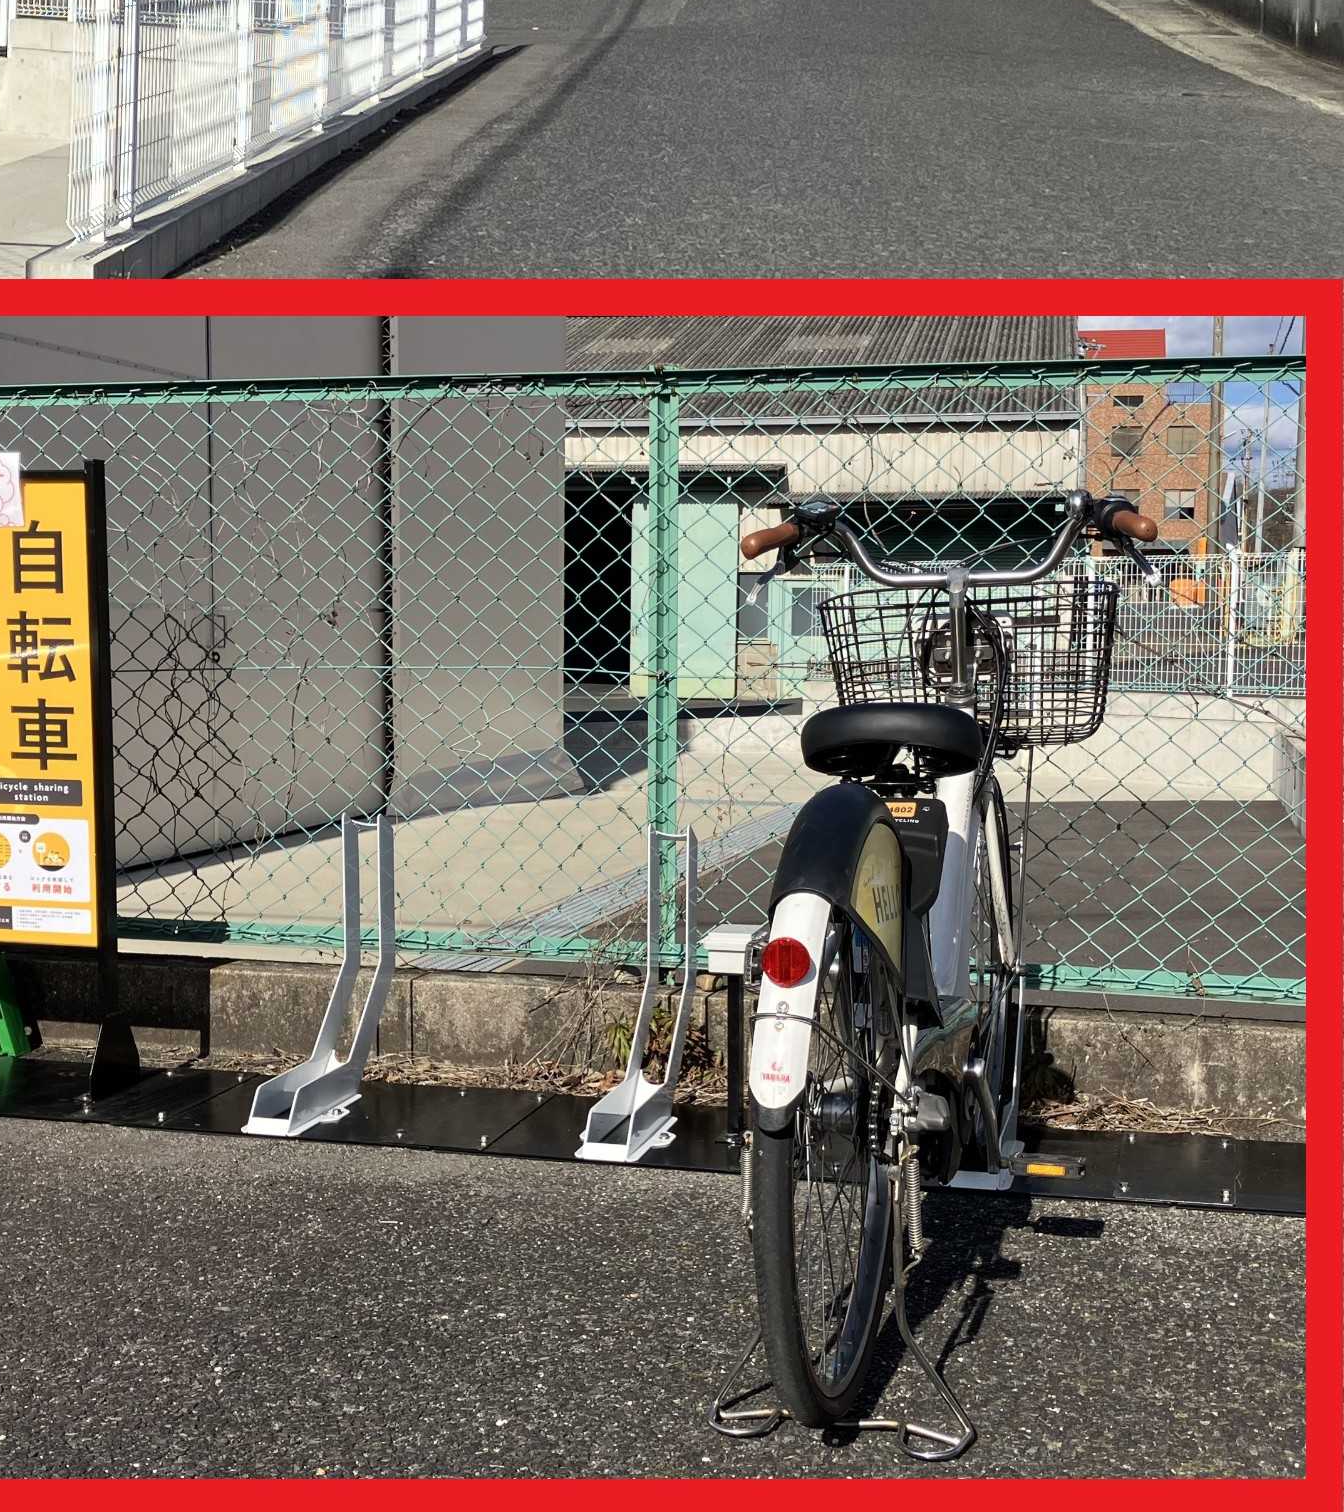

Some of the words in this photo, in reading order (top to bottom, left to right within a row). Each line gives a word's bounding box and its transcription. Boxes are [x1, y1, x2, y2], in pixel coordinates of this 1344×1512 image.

[6, 520, 77, 771] 自転車
[33, 783, 70, 794] sharing
[14, 793, 49, 802] station
[893, 817, 920, 825] YCLING
[31, 883, 73, 895] 利用開始
